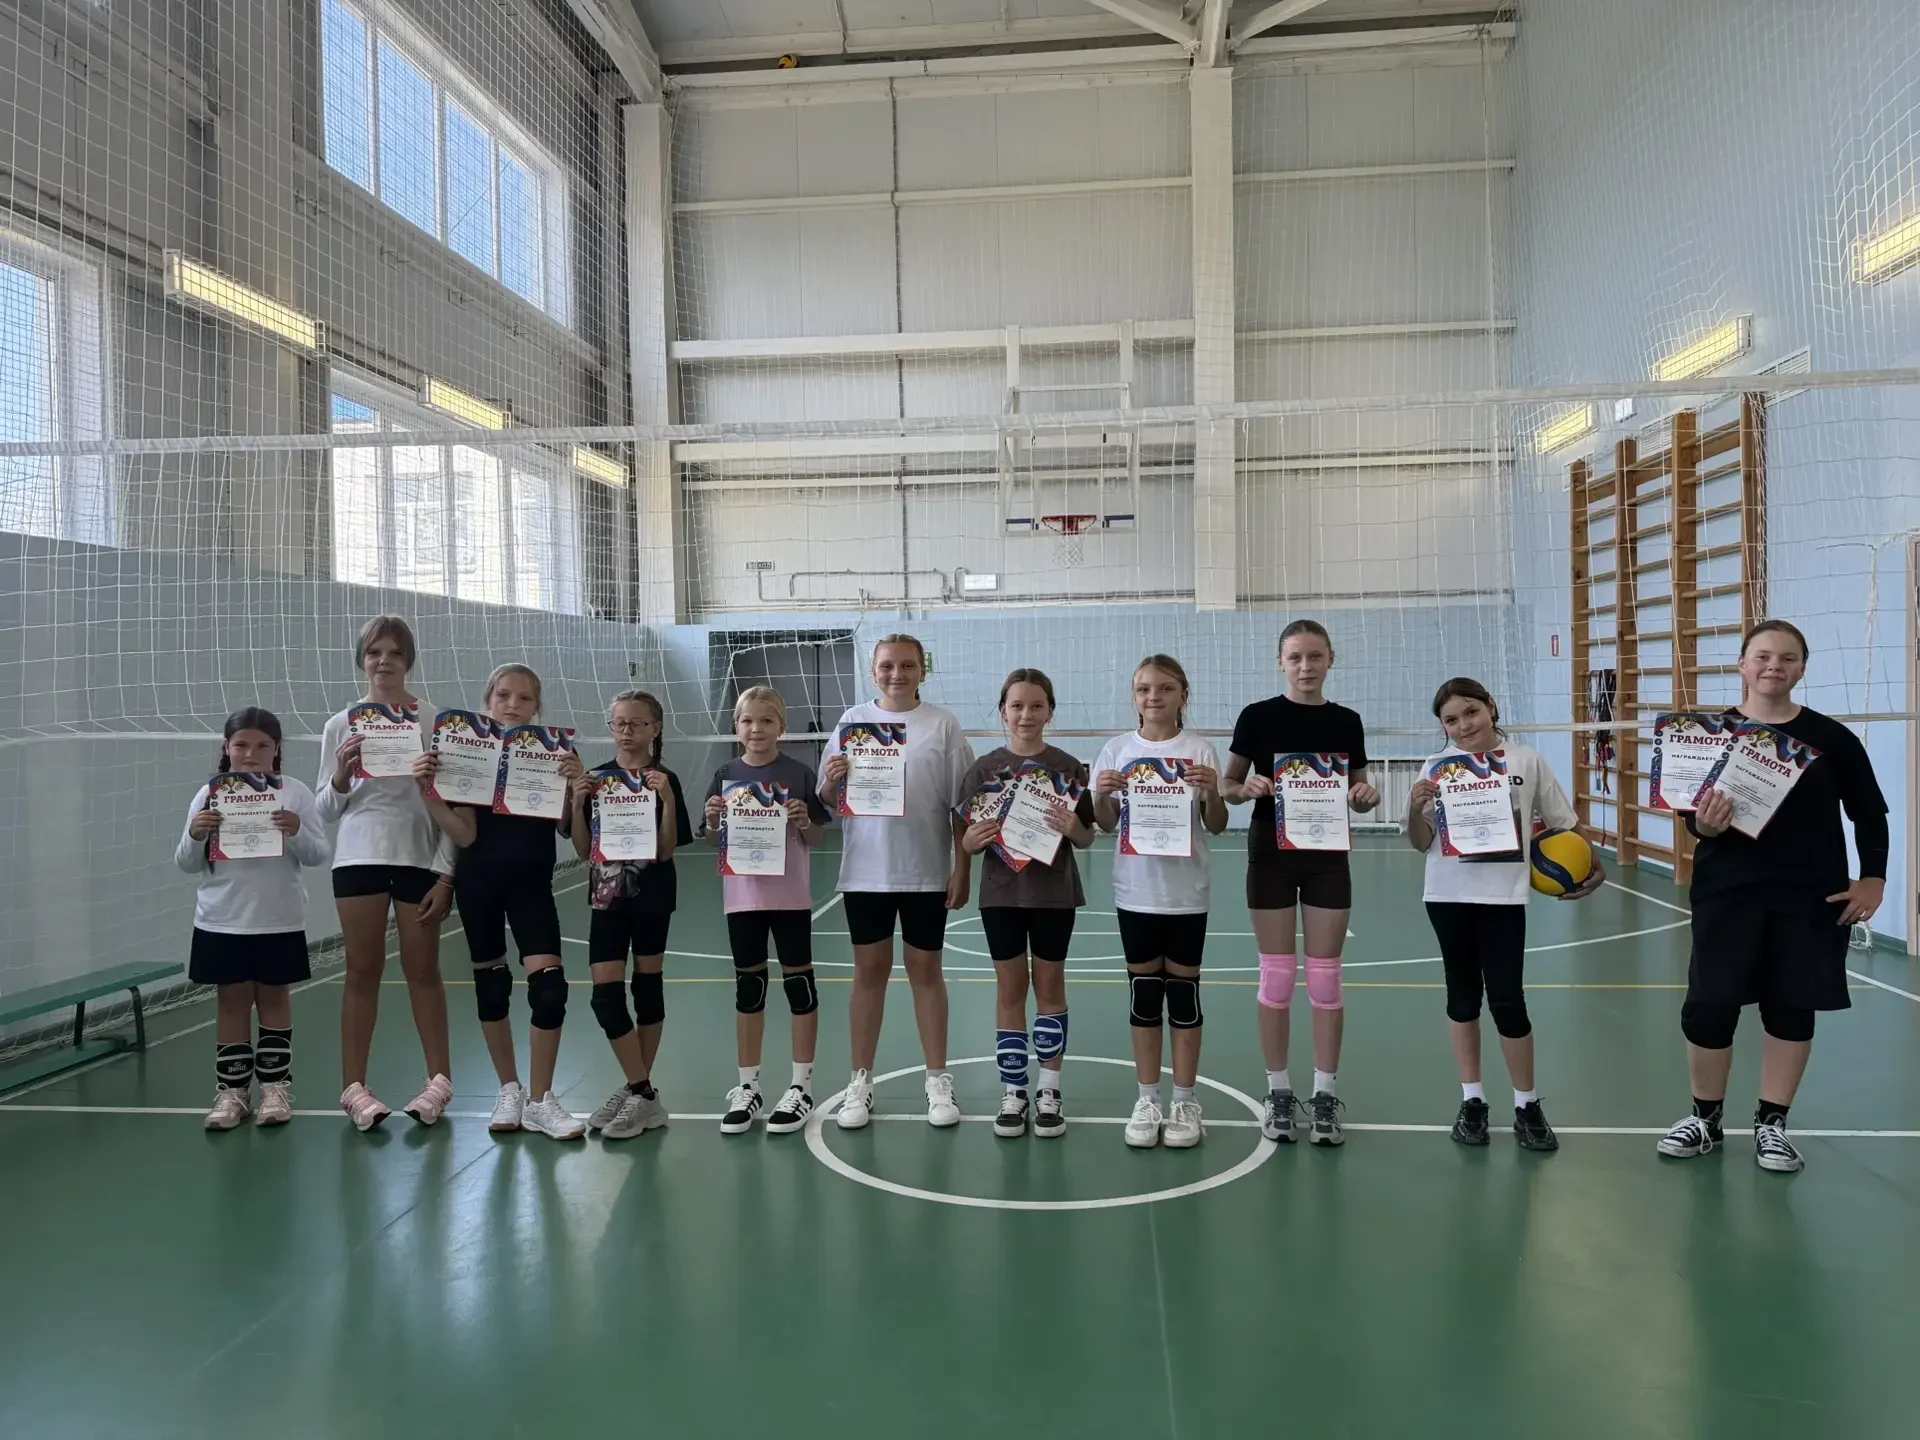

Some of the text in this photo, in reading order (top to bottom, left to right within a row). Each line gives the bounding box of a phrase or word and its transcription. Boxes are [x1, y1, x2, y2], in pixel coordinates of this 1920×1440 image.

[445, 734, 496, 750] ГРАМОТА
[1669, 734, 1729, 747] ГРАМОТА
[446, 752, 488, 762] НАГРАЖДАЕТСЯ
[852, 748, 900, 757] ГРАМОТА
[1671, 754, 1718, 762] НАГРАЖДАЕТС
[1739, 745, 1793, 778] ГРАМОТА
[516, 767, 557, 775] НАГРАЖДАЕТСЯ
[1735, 764, 1777, 788] НАГРАЖДАЕТСЯ
[1288, 780, 1341, 789] ГРАМОТА
[1446, 780, 1502, 793] ГРАМОТА
[1134, 785, 1185, 795] ГРАМОТА
[224, 793, 276, 804] ГРАМОТА
[604, 795, 650, 804] ГРАМОТА
[1023, 783, 1069, 810] ГРАМОТА
[1452, 799, 1498, 808] НАГРАЖДАЕТСЯ
[732, 808, 781, 817] ГРАМОТА
